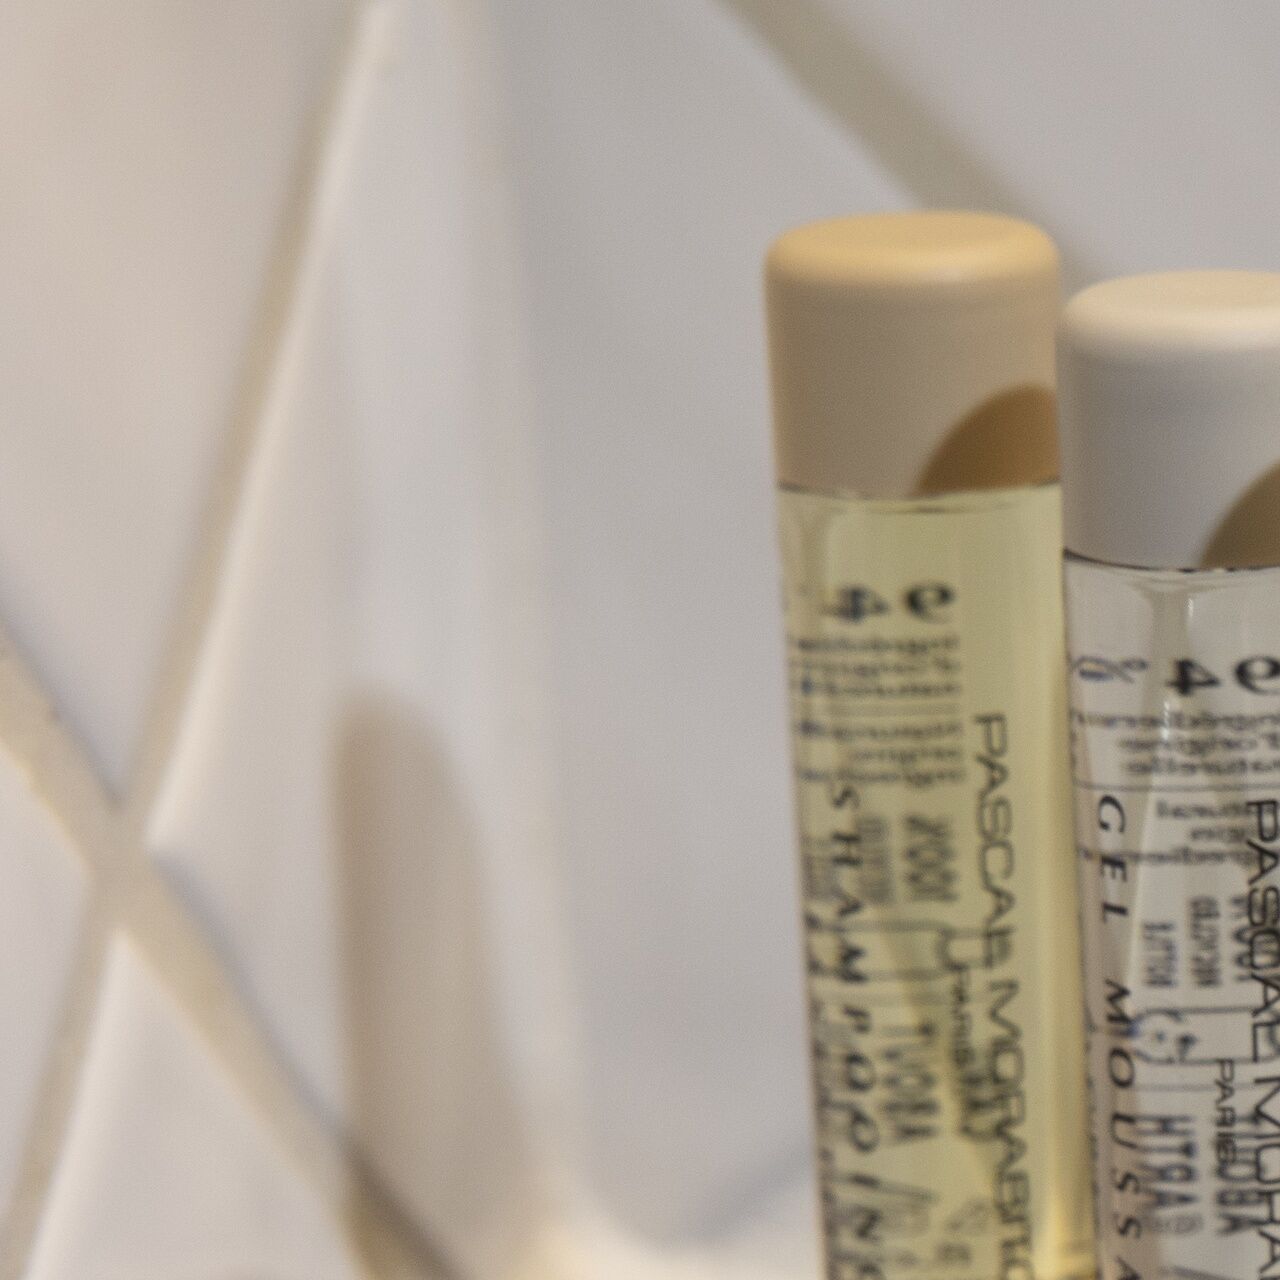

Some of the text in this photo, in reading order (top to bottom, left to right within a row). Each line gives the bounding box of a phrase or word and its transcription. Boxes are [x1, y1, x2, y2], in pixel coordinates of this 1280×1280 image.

[974, 713, 1015, 968] PASCAL
[1099, 795, 1129, 924] GEL
[1215, 1058, 1237, 1164] PARIS
